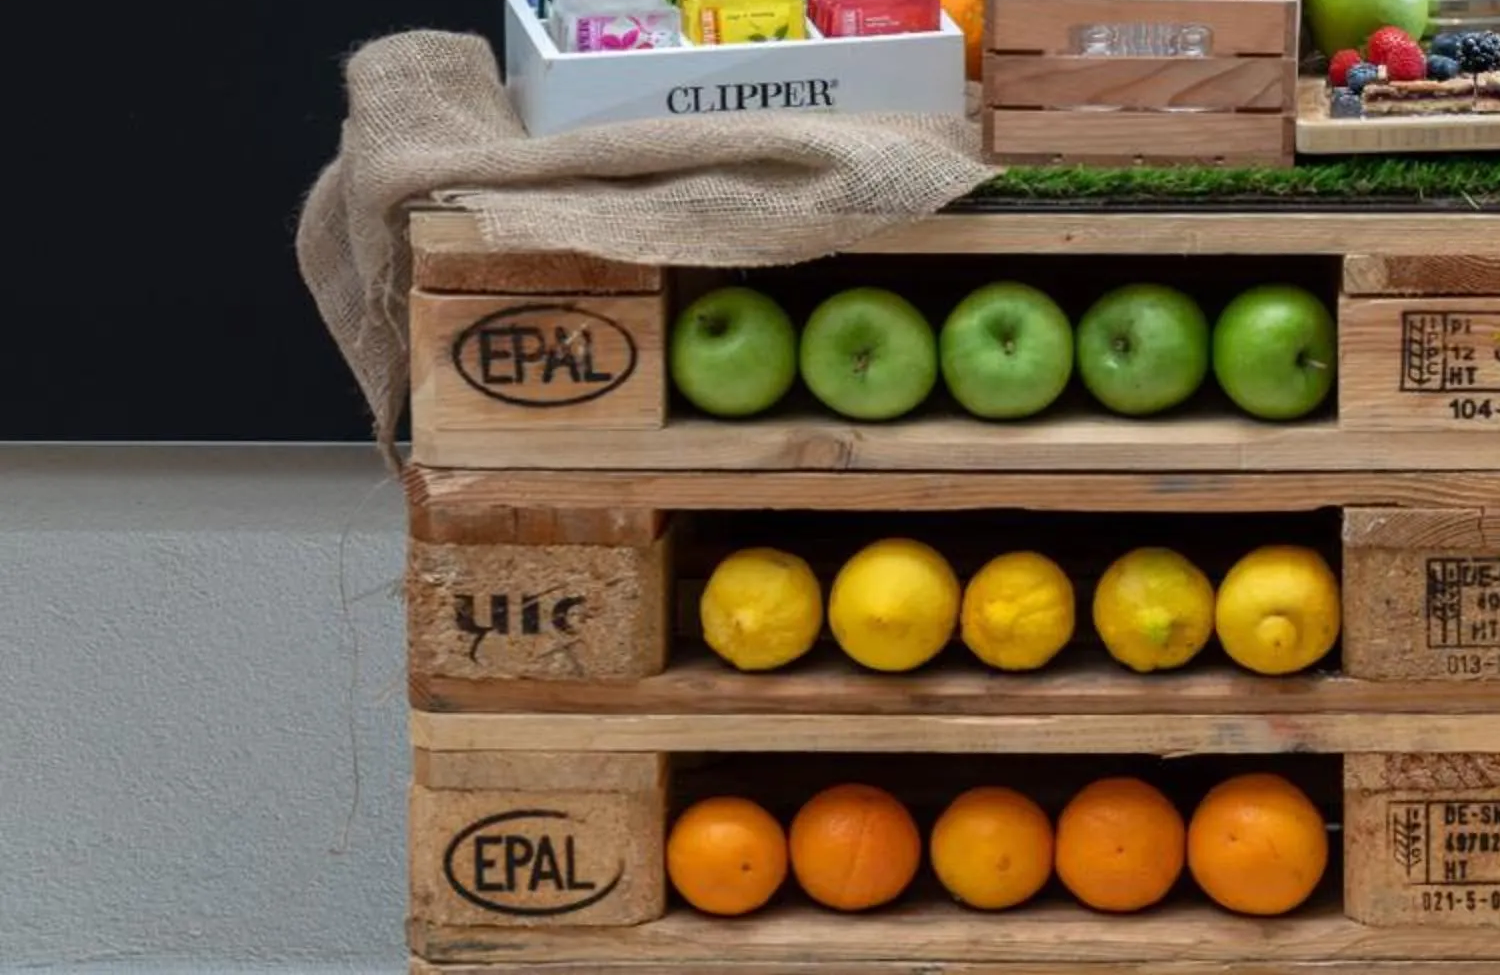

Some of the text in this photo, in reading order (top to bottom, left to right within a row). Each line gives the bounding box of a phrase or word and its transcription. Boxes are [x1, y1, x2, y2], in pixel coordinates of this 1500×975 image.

[479, 325, 613, 384] EPAL
[1449, 366, 1478, 386] HT
[474, 834, 596, 893] EPAL
[1444, 860, 1469, 881] HT
